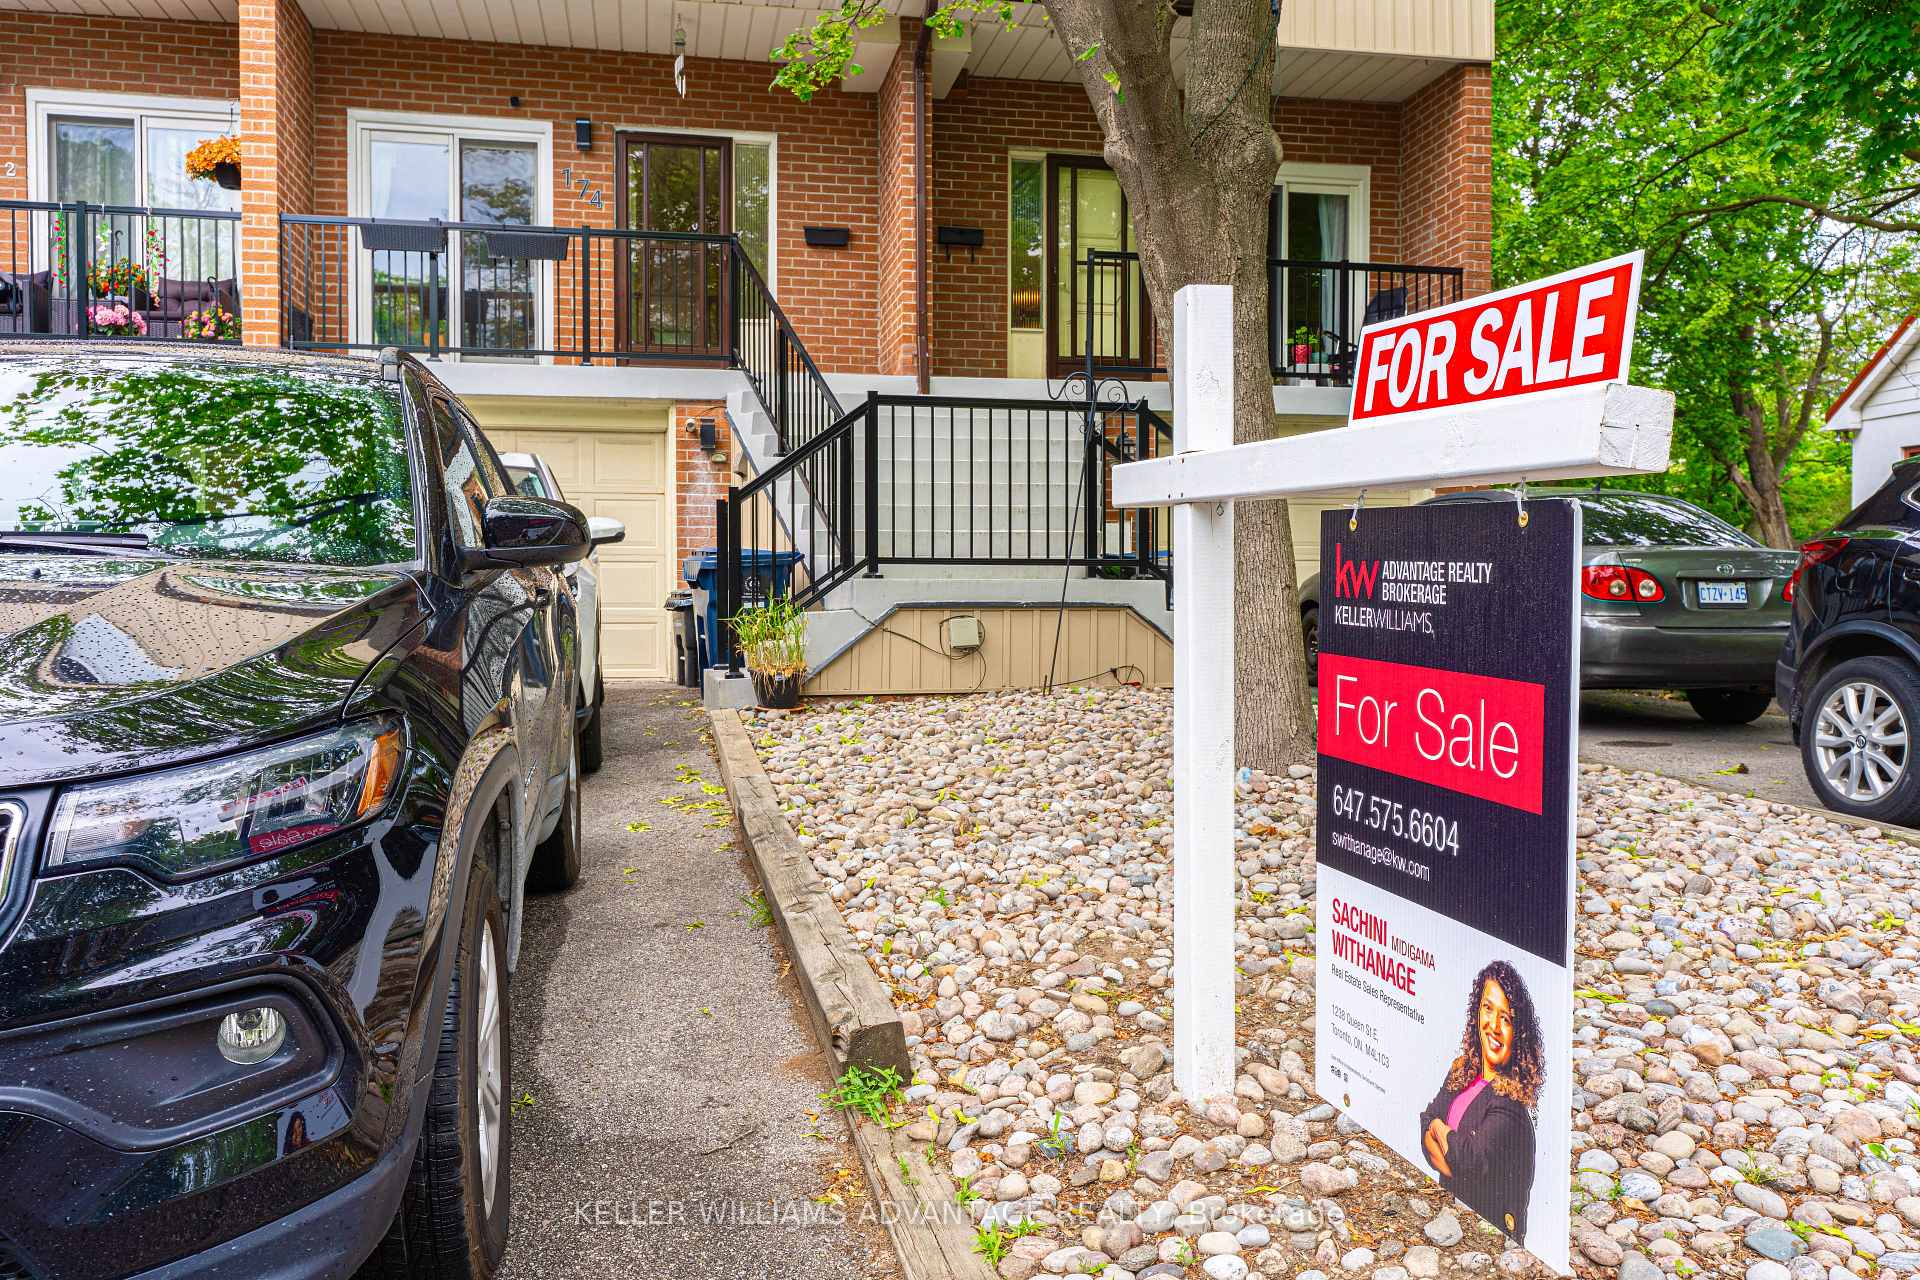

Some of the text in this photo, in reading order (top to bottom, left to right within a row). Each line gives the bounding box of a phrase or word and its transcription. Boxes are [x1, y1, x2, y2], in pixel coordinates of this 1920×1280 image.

[5, 161, 16, 177] 2
[561, 168, 604, 209] 174
[1363, 275, 1615, 408] FOR SALE
[1335, 543, 1381, 600] kw
[1381, 560, 1493, 584] ADVANTAGE REALTY
[1381, 582, 1447, 605] BROKERAGE
[1335, 674, 1519, 779] For Sale
[1333, 784, 1459, 857] 647.575.6604
[1332, 832, 1430, 882] swithanage@kw.com
[1331, 929, 1417, 997] WITHANAGE
[1332, 897, 1436, 971] SACHINI MIDIGAMA
[1331, 963, 1425, 1025] Real Estate Sales Representative
